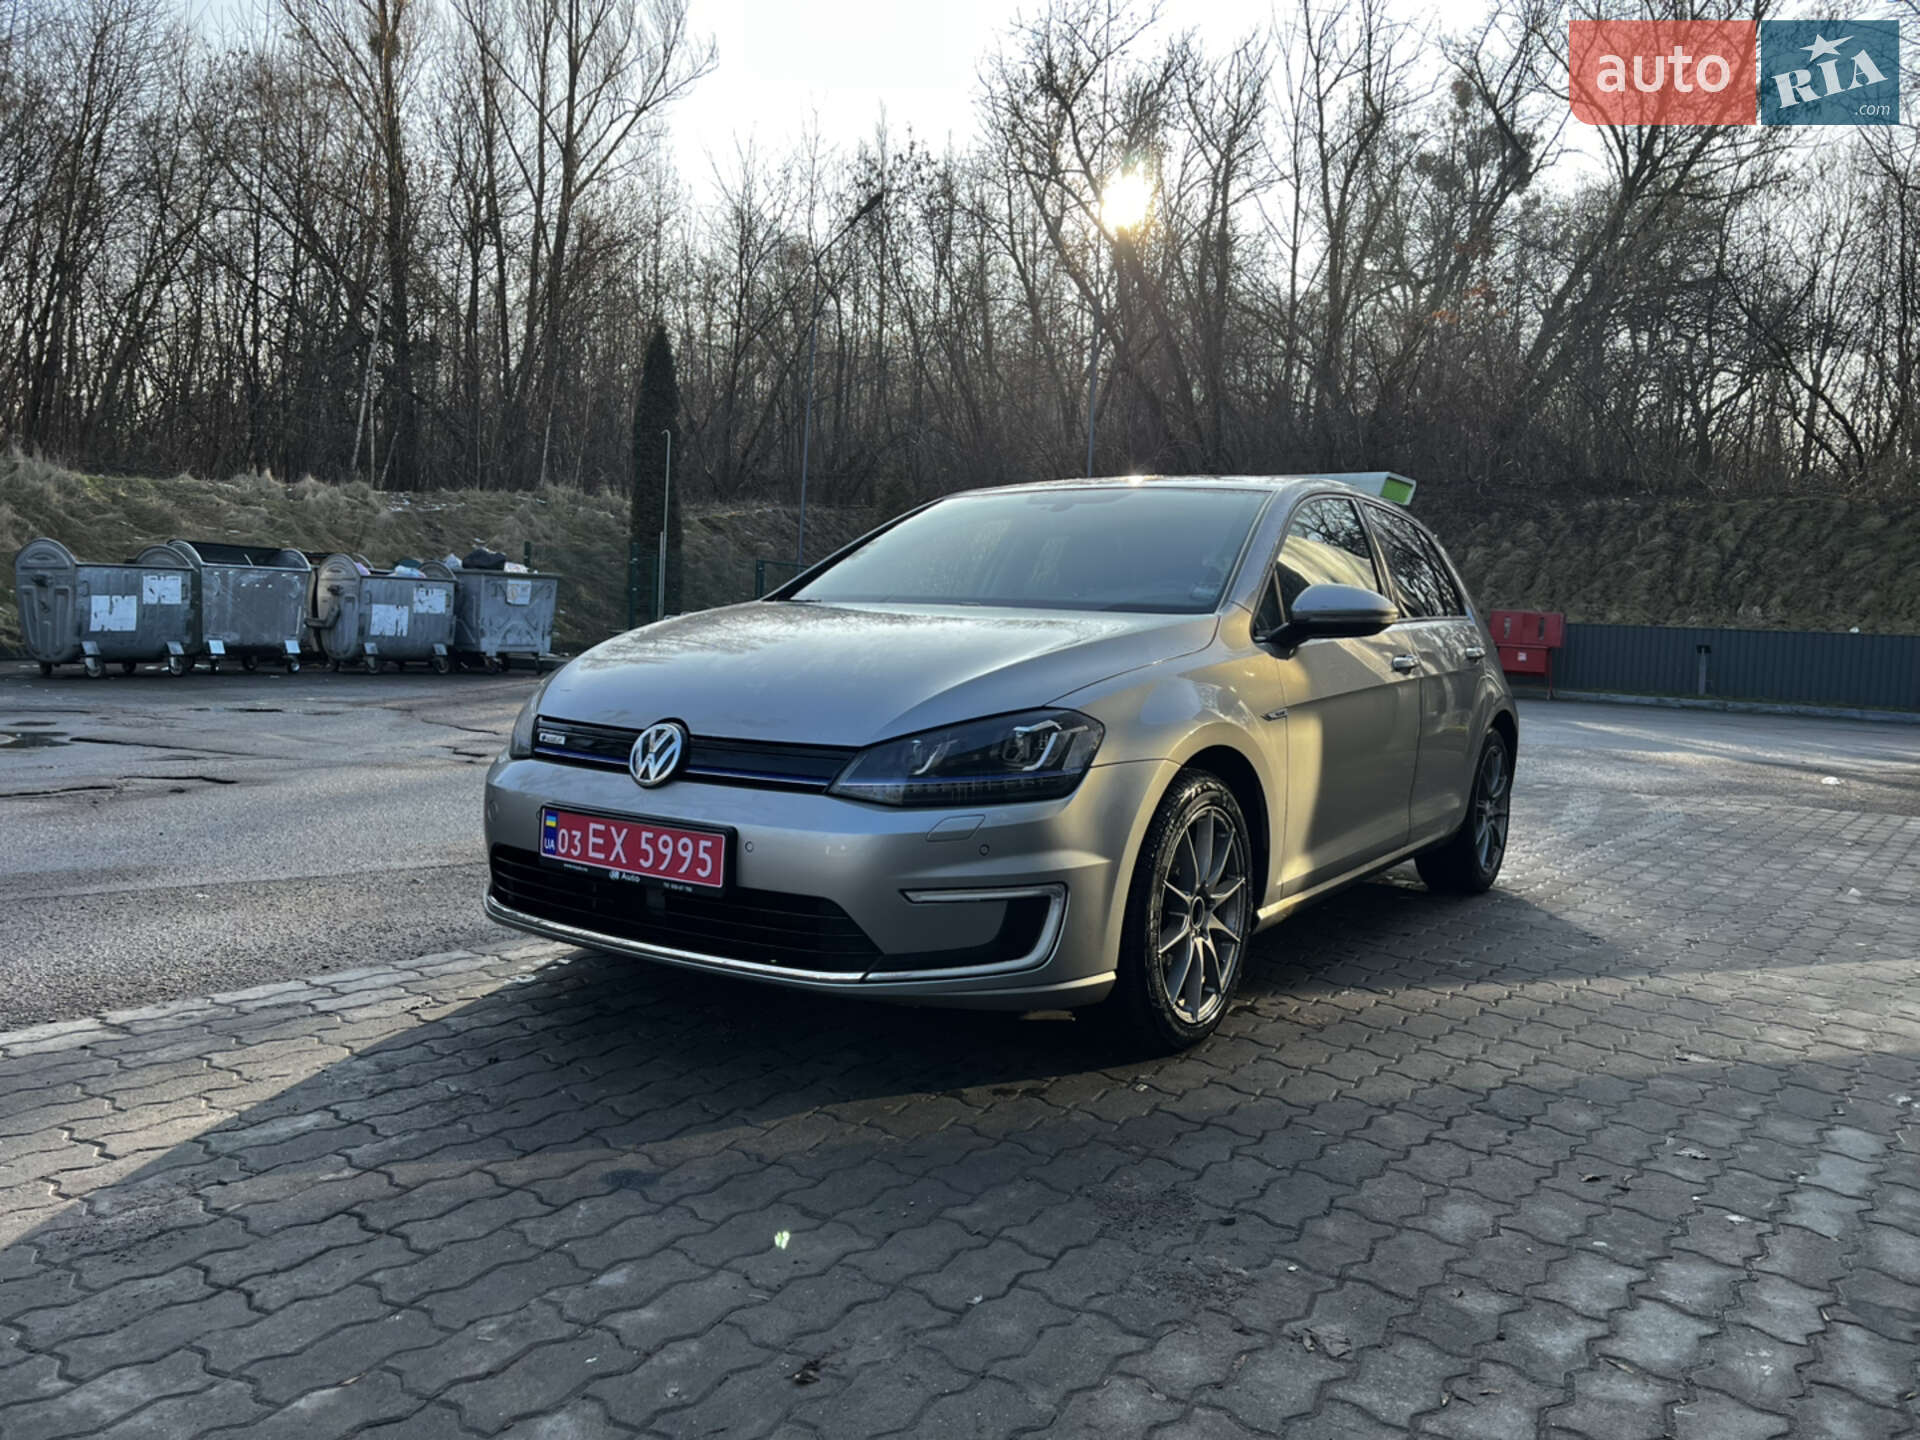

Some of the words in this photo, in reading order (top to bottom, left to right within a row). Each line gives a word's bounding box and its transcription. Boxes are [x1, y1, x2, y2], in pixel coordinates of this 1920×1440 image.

[630, 724, 682, 783] VW
[544, 837, 556, 849] UA
[558, 829, 582, 856] 03
[588, 823, 628, 864] EX
[639, 831, 713, 878] 5995
